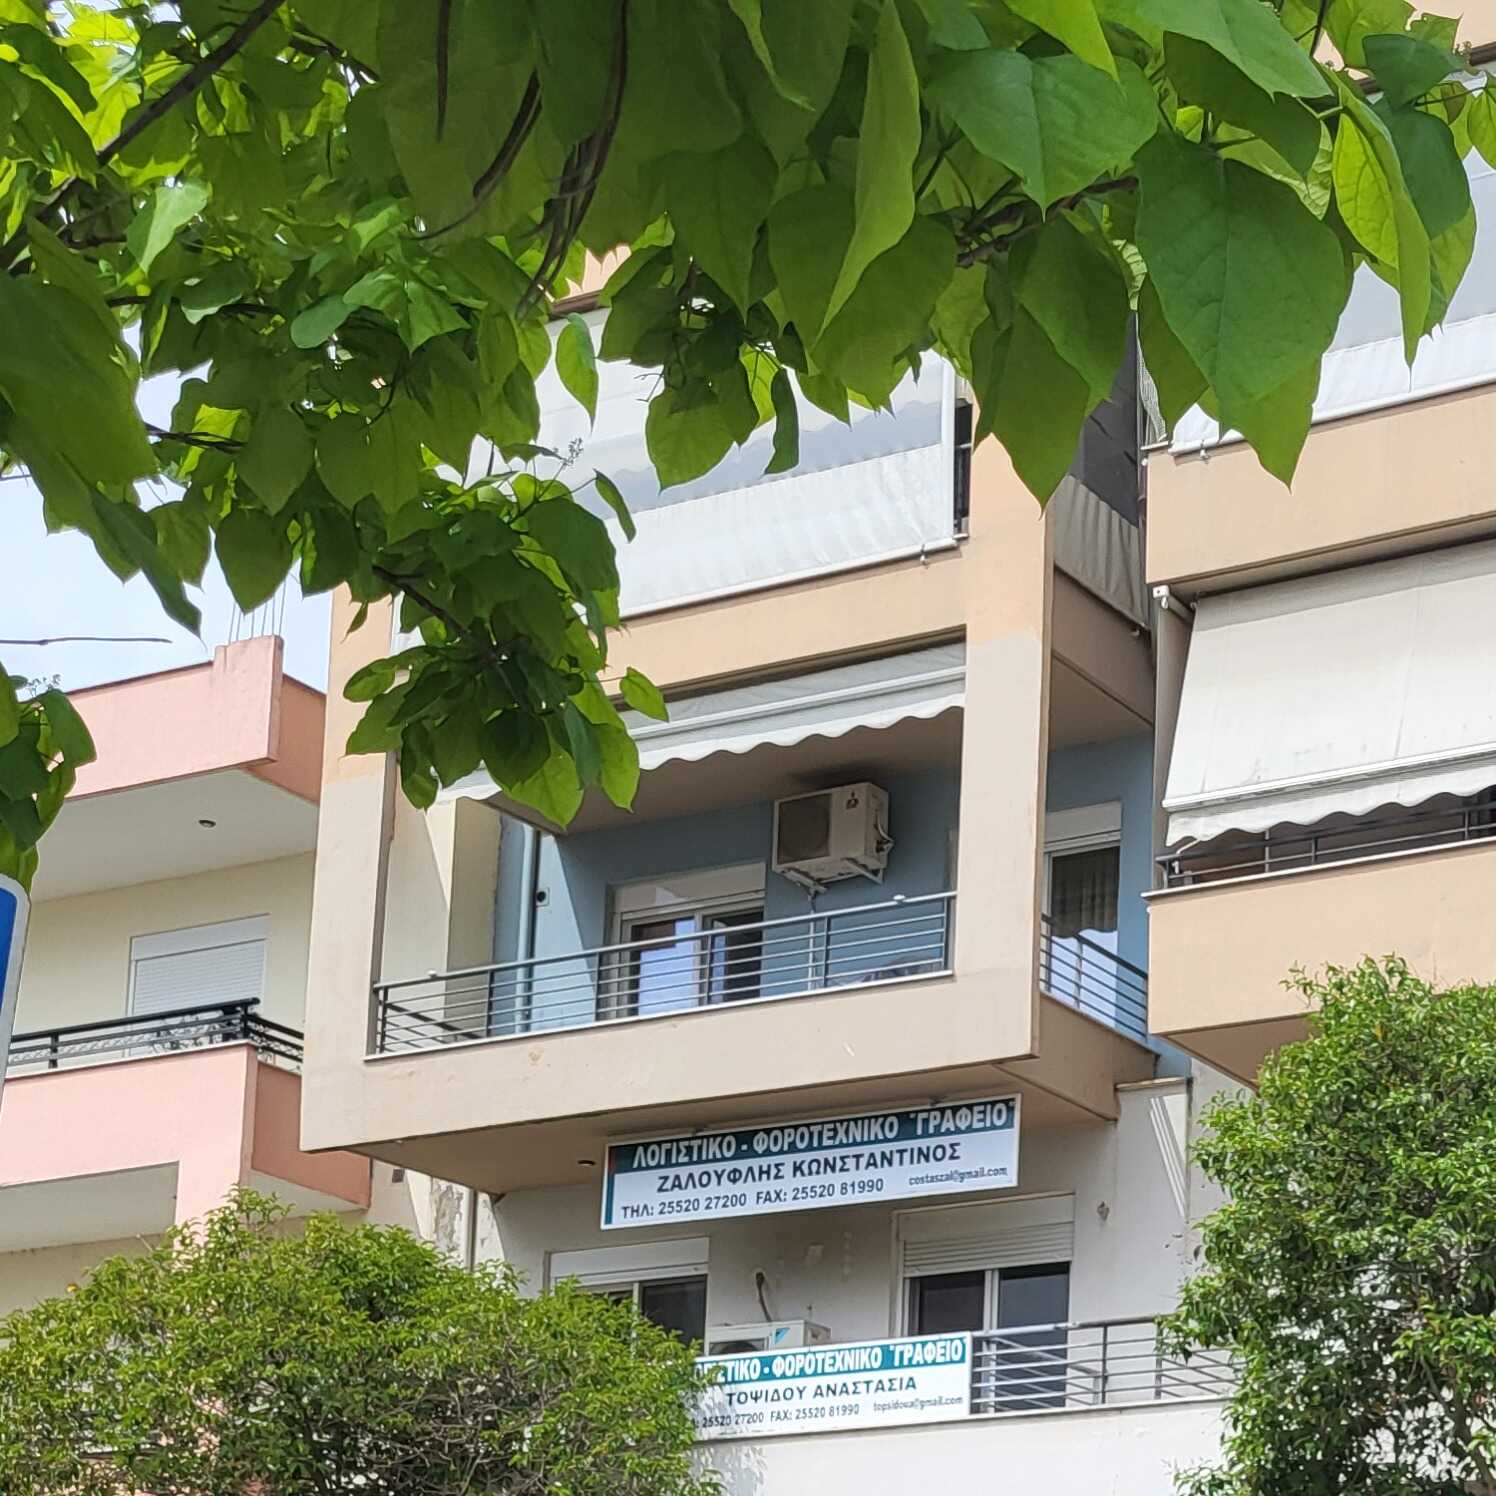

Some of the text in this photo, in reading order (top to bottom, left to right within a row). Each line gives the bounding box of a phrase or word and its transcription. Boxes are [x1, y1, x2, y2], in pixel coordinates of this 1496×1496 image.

[632, 1135, 737, 1169] ΛΟΓΙΣΤΙΚΟ
[752, 1116, 899, 1154] ΦΟΡΟΤΕΧΝΙΚΟ
[656, 1142, 961, 1193] ΖΑΛΟΥΦΛΗΣ ΚΩΝΣΤΑΝΤΙΝΟΣ
[621, 1178, 883, 1219] ΤΗΛ: 25520 27200 FAX: 25520 81990
[771, 1346, 882, 1378] ΦΟΡΟΤΕΧΝΙΚΟ
[726, 1376, 917, 1406] ΤΟΨΙΔΟΥ ΑΝΑΣΤΑΣΙΑ
[702, 1414, 732, 1429] 25520
[735, 1411, 764, 1425] 27200
[770, 1409, 793, 1421] FAX:
[795, 1406, 826, 1420] 25520
[829, 1403, 860, 1417] 81990
